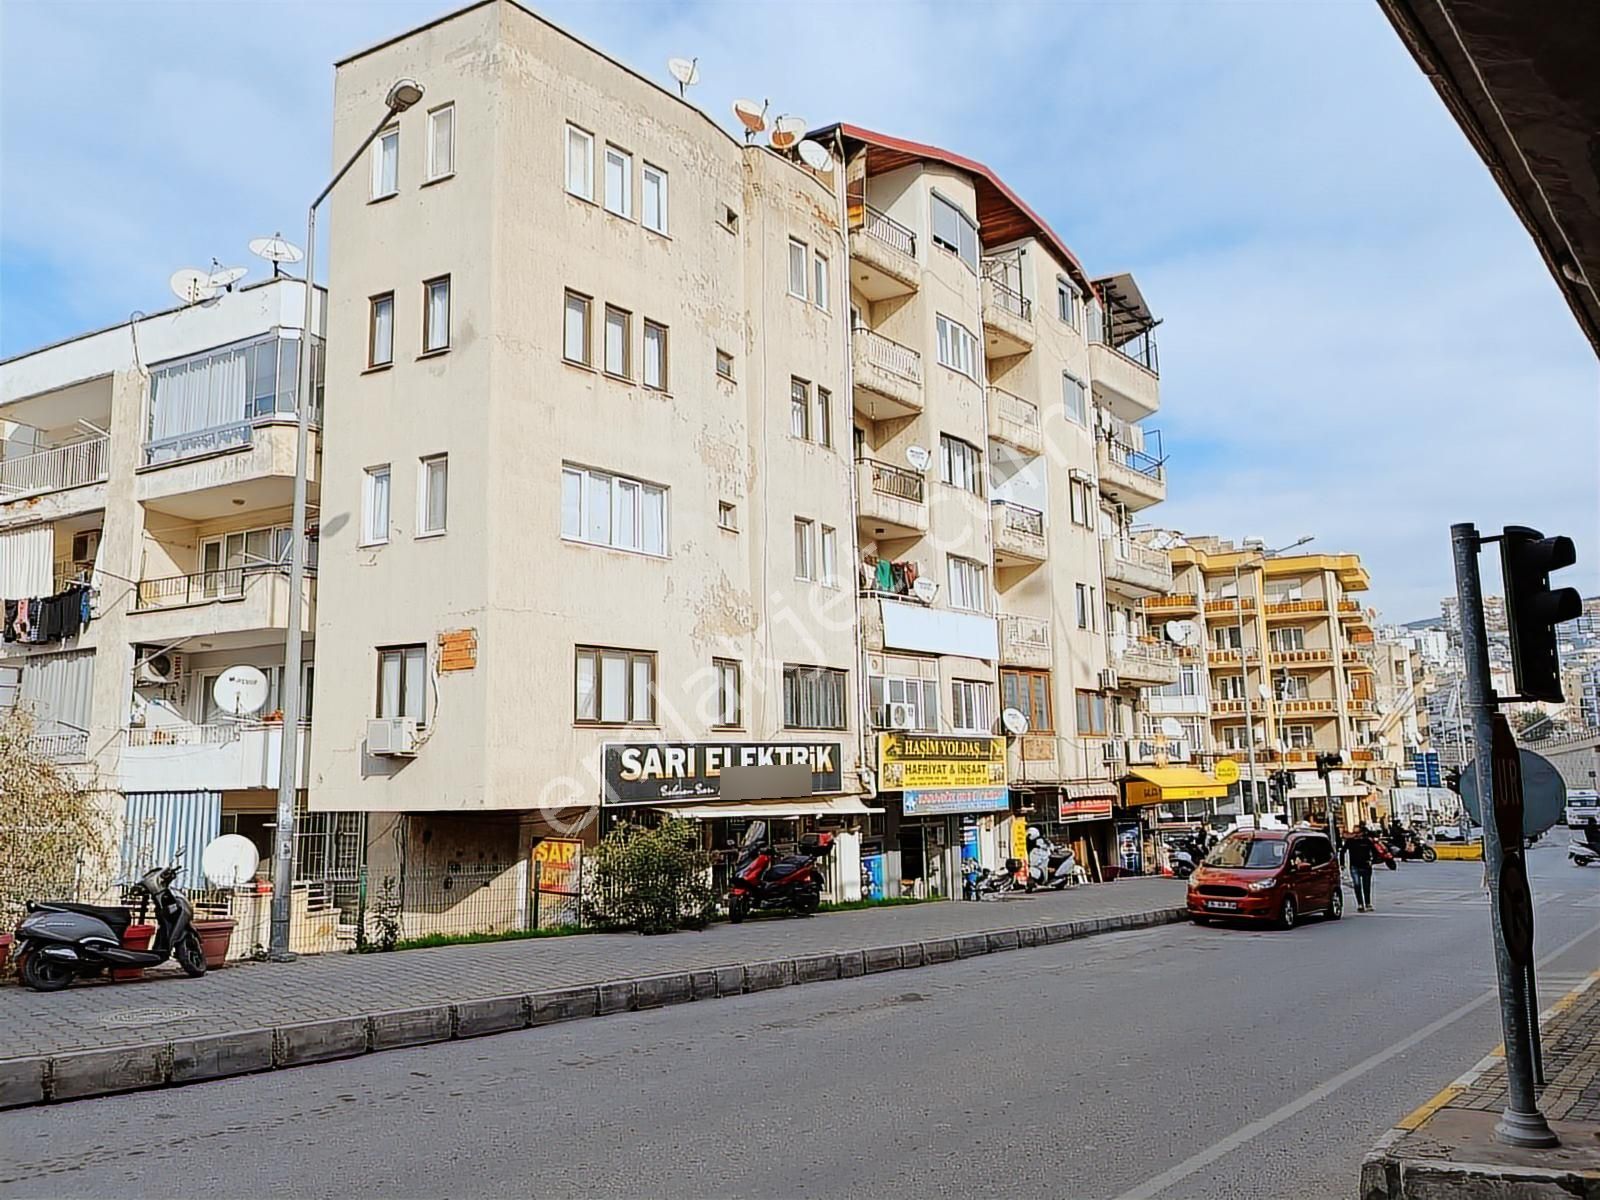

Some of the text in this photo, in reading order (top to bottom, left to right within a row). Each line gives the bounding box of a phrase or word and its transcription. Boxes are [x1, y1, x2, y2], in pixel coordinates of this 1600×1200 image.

[904, 737, 981, 759] HAŞİM YOLDAŞ
[619, 746, 696, 781] SARI
[904, 762, 947, 775] HAFRİYAT
